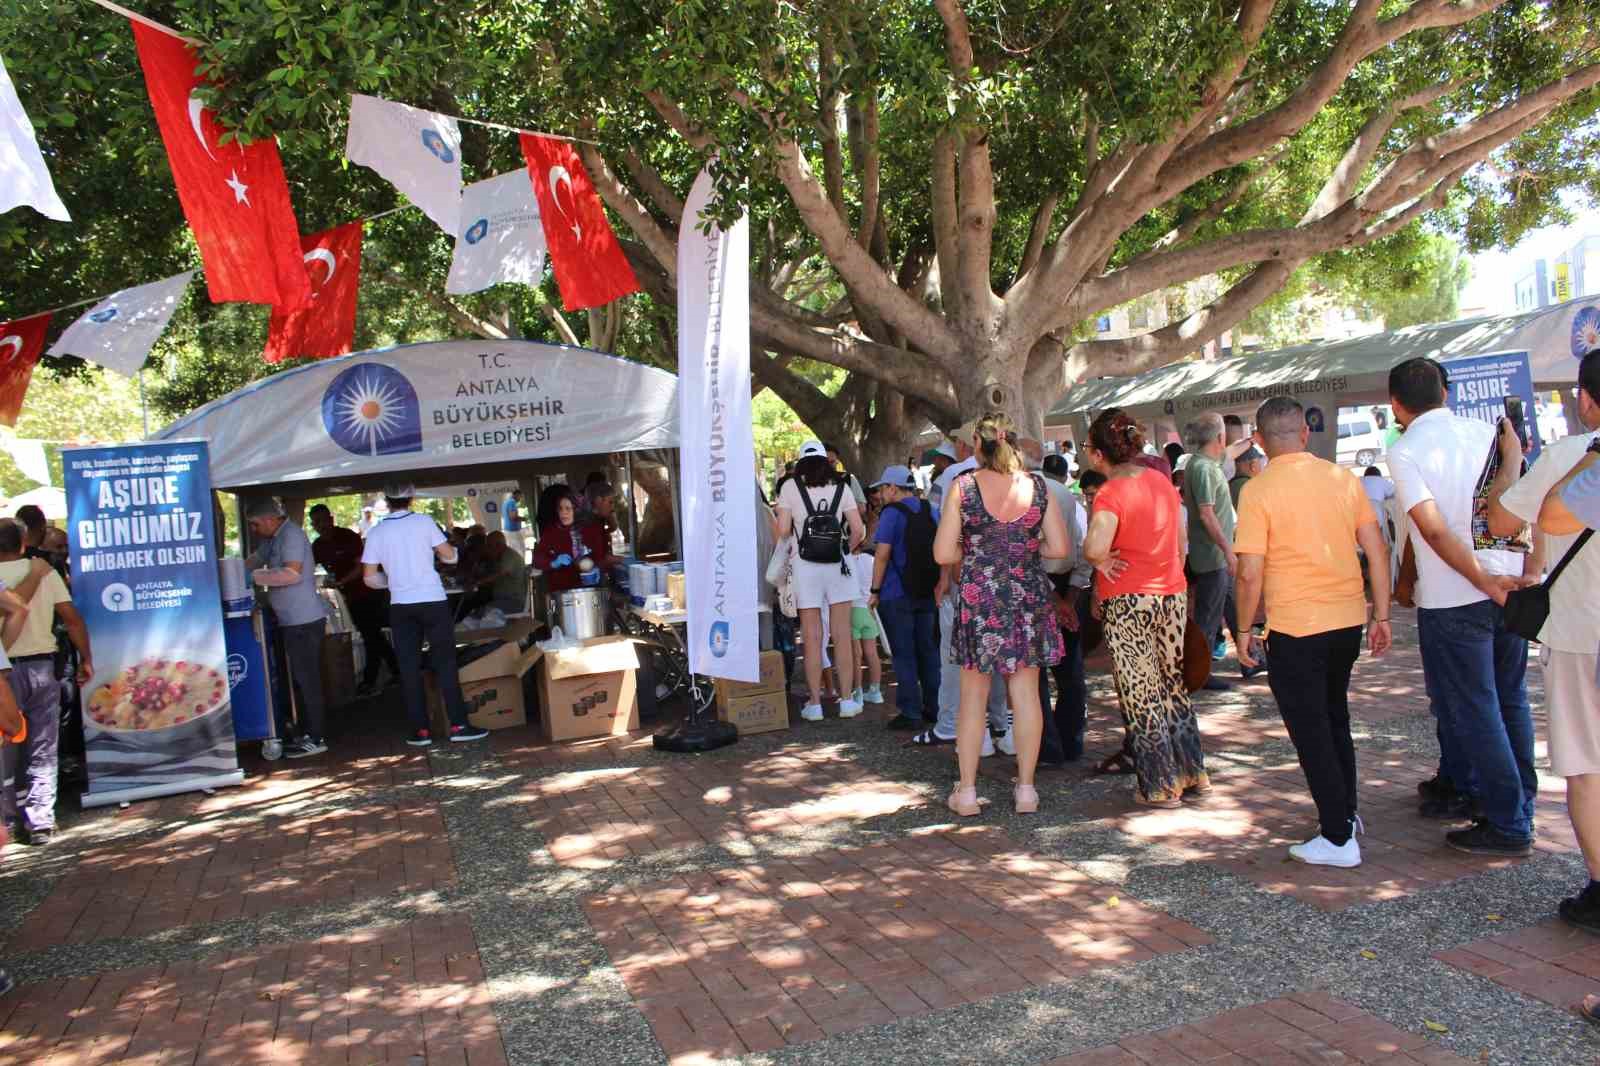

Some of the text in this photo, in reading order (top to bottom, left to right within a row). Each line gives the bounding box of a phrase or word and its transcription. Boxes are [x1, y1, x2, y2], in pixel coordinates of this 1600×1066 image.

[477, 353, 511, 370] T.C.
[455, 376, 541, 398] ANTALYA
[1294, 377, 1348, 394] BELEDİYESİ
[1457, 377, 1511, 404] AŞURE
[433, 396, 565, 426] BÜYÜKŞEHİR
[452, 422, 551, 449] BELEDİYESİ
[98, 475, 180, 512] AŞURE
[78, 508, 204, 549] GÜNÜMÜZ
[81, 545, 206, 573] MÜBAREK OLSUN
[714, 511, 727, 617] ANTALYA
[135, 580, 174, 591] ANTALYA
[136, 587, 192, 601] BÜYÜKŞEHİR
[136, 597, 182, 611] BELEDİYESİ
